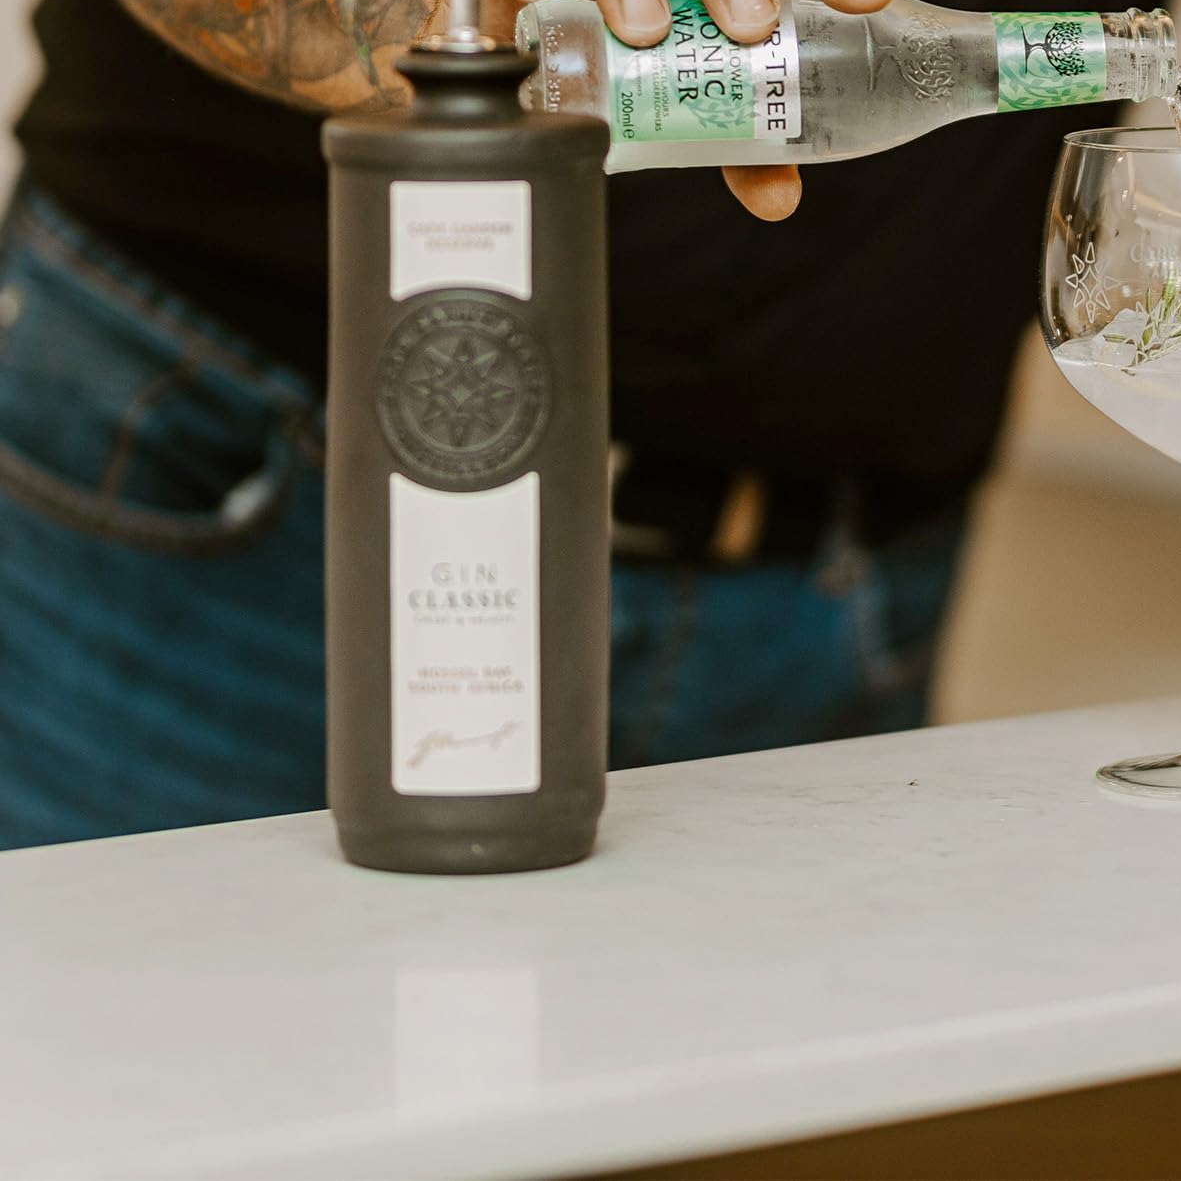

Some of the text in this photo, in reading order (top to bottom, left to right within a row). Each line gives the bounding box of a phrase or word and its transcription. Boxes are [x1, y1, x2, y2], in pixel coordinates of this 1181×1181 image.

[671, 7, 699, 105] WATER
[762, 22, 787, 131] R-TREE
[621, 91, 635, 127] 200ml
[431, 561, 498, 587] GIN
[407, 587, 522, 611] CLASSIC
